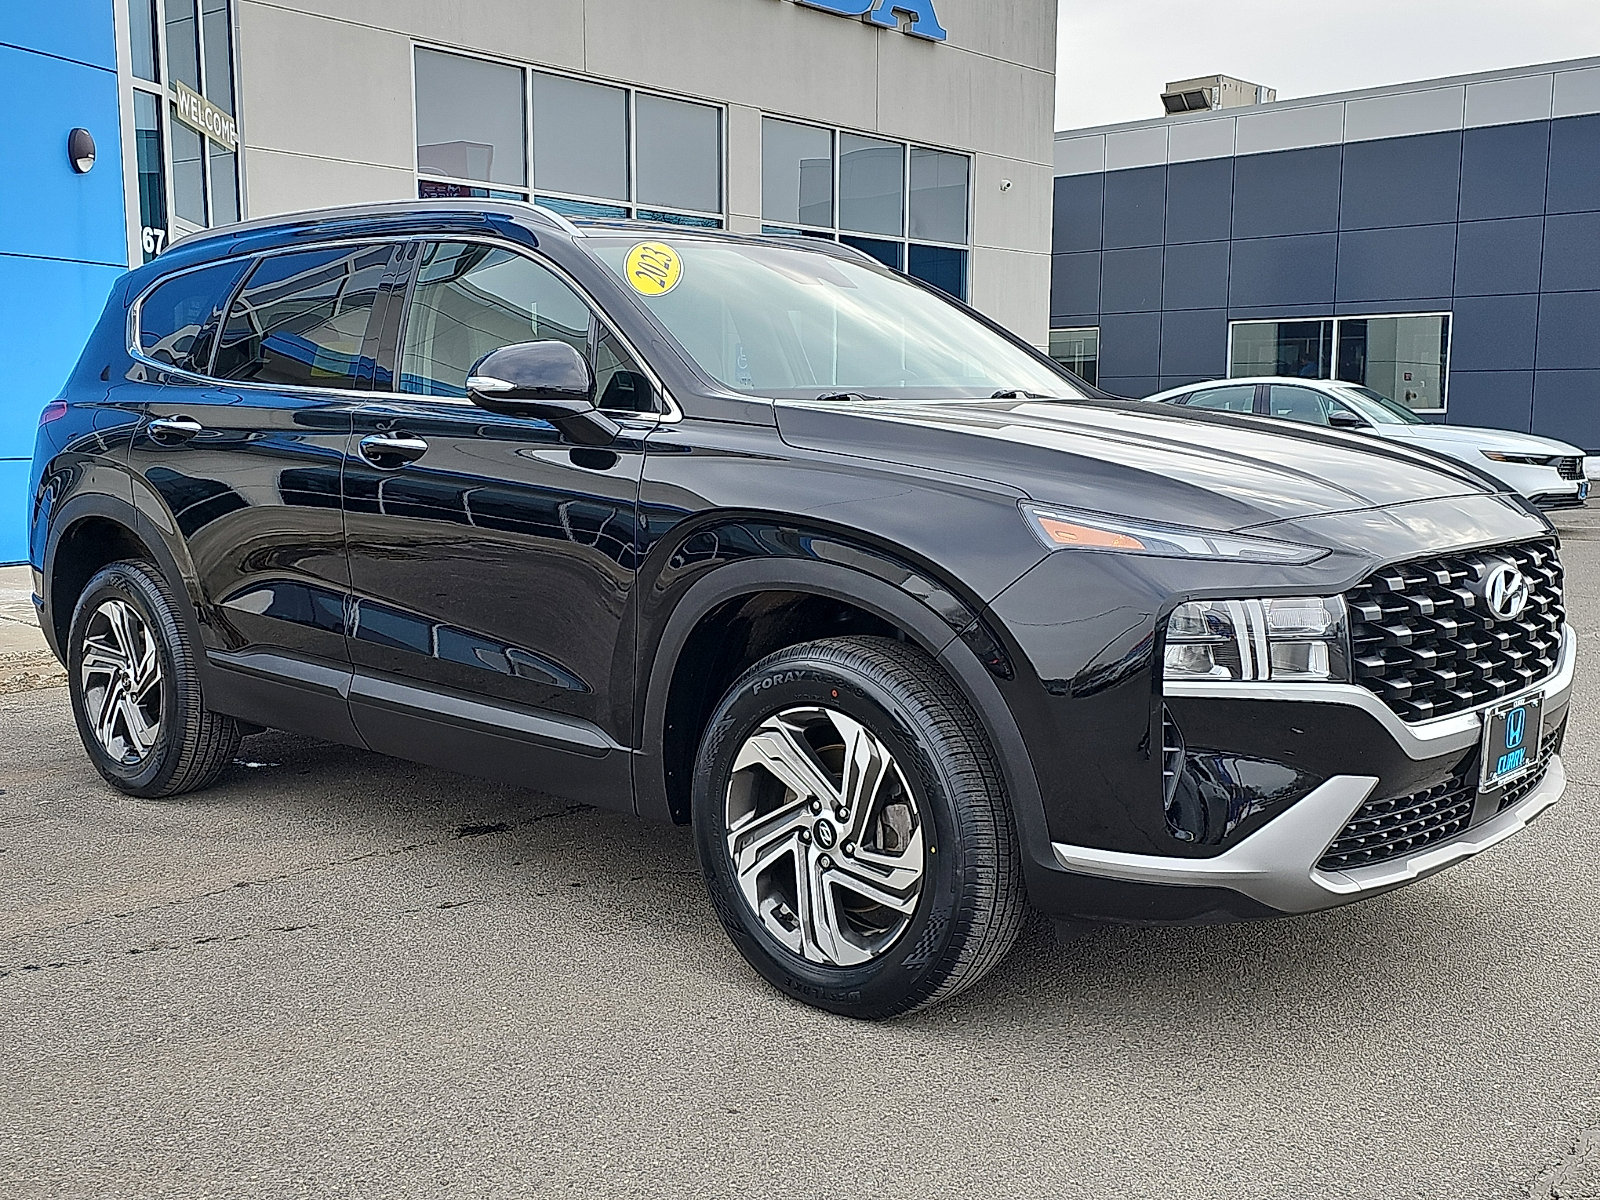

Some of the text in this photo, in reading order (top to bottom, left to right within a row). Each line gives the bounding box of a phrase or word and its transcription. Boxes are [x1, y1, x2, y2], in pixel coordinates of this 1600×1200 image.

[177, 86, 235, 146] WELCOME
[143, 226, 165, 255] 67
[636, 247, 672, 288] 2023
[752, 671, 806, 696] FORAY
[1497, 746, 1527, 775] CURRY
